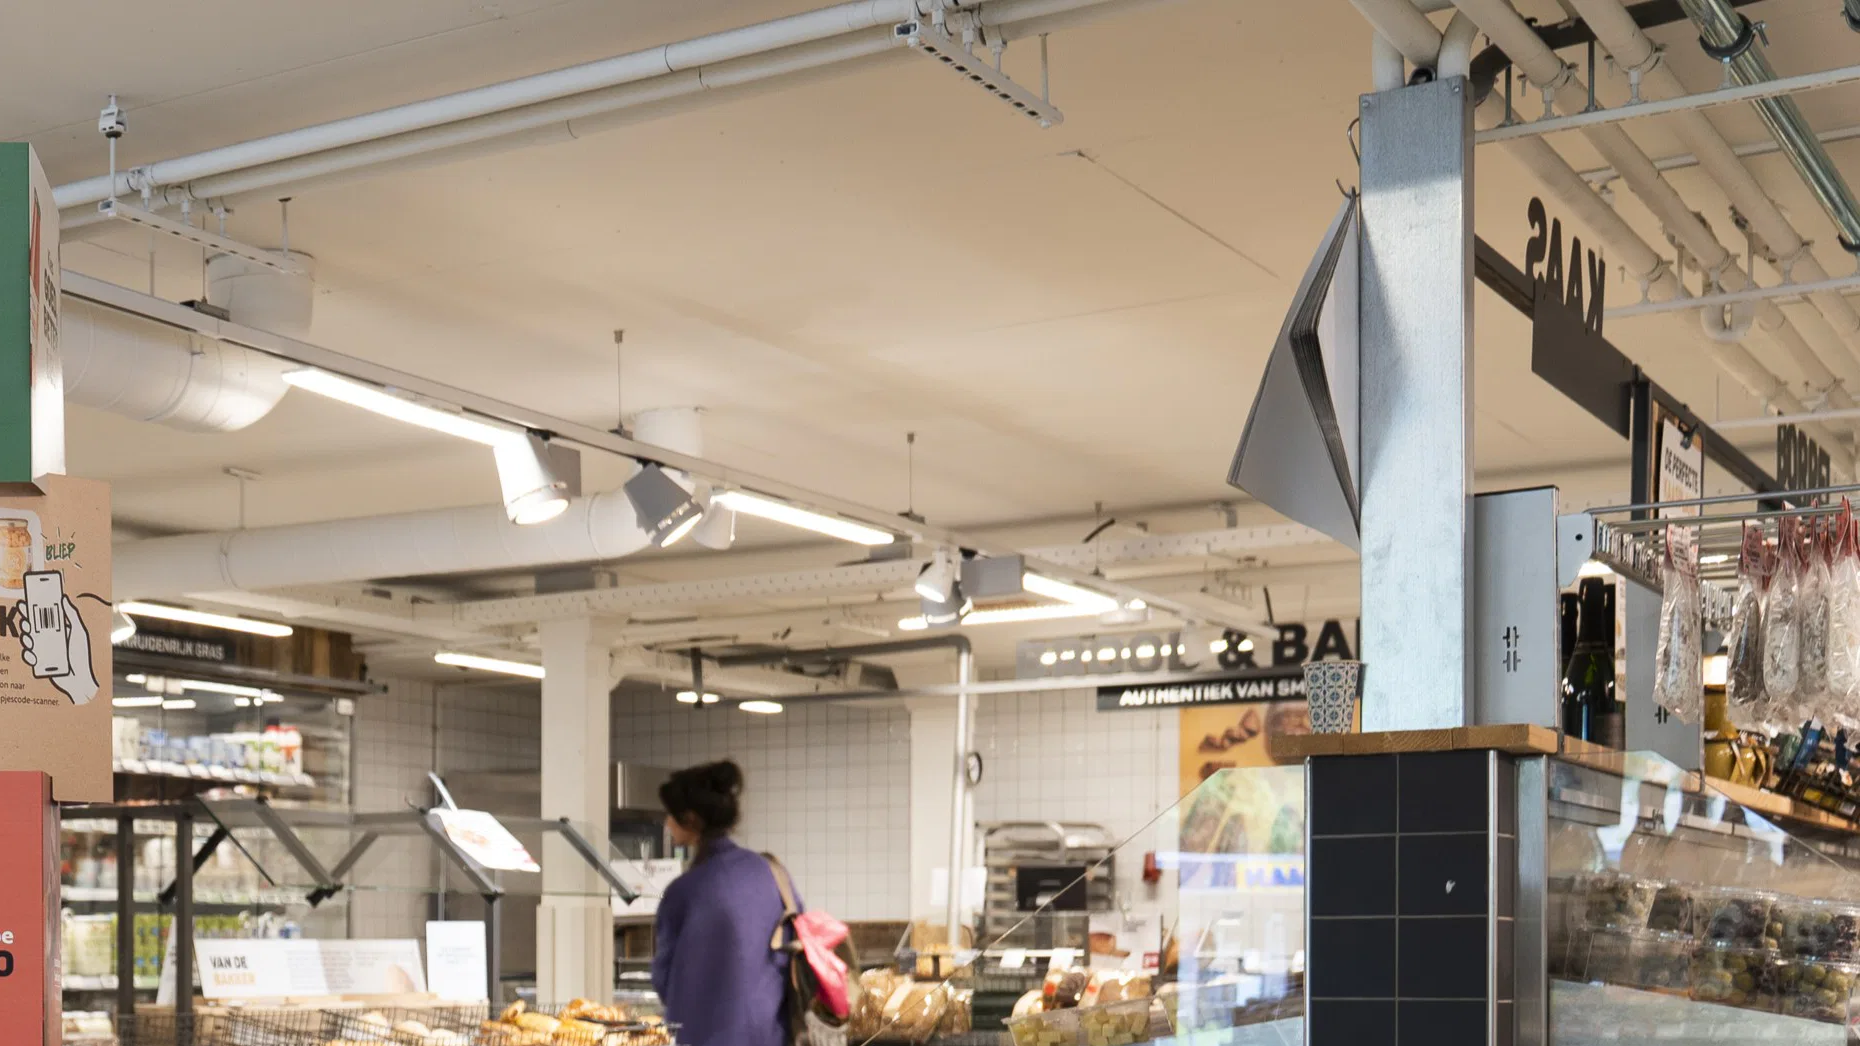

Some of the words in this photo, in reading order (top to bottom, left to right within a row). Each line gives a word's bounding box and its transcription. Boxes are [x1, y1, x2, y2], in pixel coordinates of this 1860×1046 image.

[1273, 618, 1361, 668] BA
[10, 682, 25, 691] naar
[1119, 682, 1233, 707] AUTHENTIEK
[1236, 680, 1274, 699] VAN
[1277, 680, 1306, 696] SM
[210, 956, 232, 969] VAN
